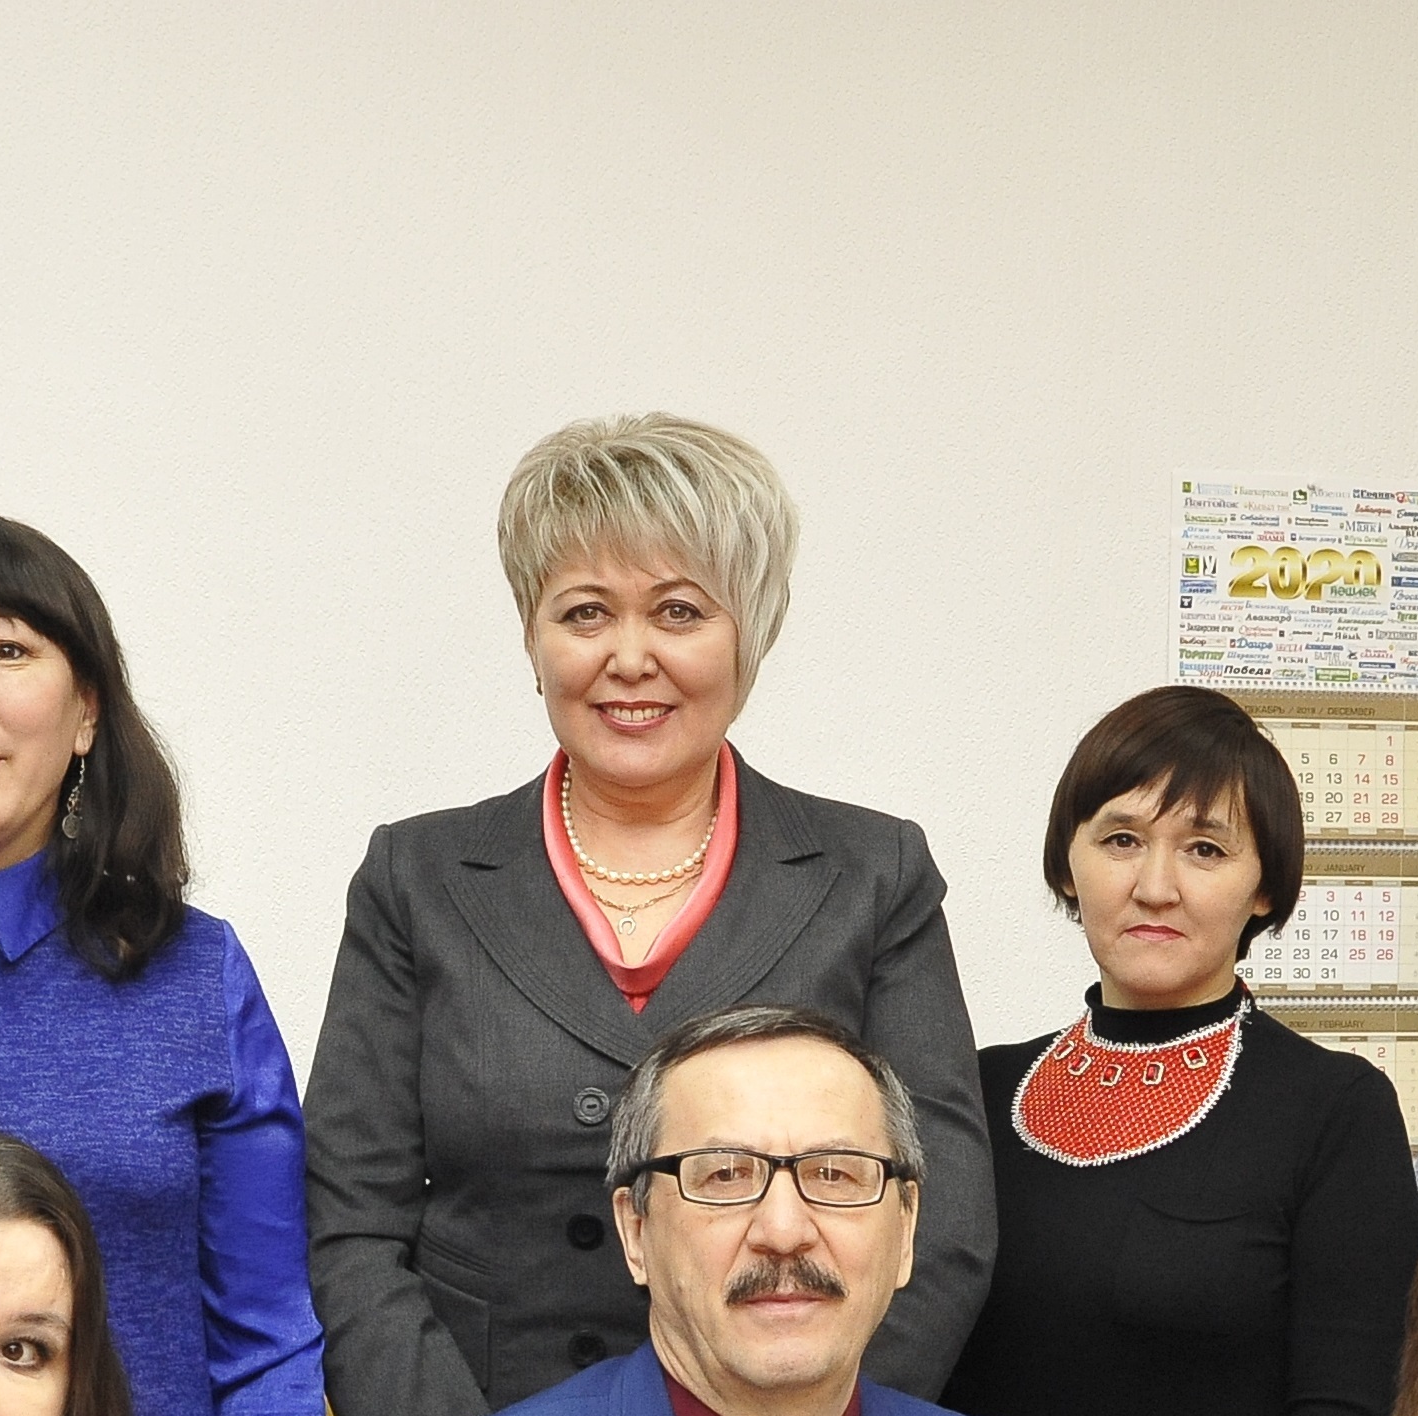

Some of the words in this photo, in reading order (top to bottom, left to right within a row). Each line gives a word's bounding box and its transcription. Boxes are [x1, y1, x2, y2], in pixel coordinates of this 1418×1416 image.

[1229, 545, 1382, 600] 2020
[1224, 665, 1272, 675] Победа
[1327, 707, 1376, 716] DECEMBER
[1387, 735, 1394, 747] 1
[1300, 753, 1311, 766] 5
[1329, 753, 1338, 766] 6
[1357, 754, 1366, 766] 7
[1385, 754, 1394, 766] 8
[1298, 772, 1314, 785] 12
[1326, 773, 1343, 785] 13
[1354, 773, 1371, 786] 14
[1382, 774, 1399, 786] 15
[1325, 792, 1343, 805] 20
[1353, 792, 1370, 805] 21
[1381, 793, 1399, 805] 22
[1325, 811, 1343, 823] 27
[1353, 812, 1371, 824] 28
[1381, 812, 1399, 824] 29
[1324, 863, 1366, 873] JANUARY
[1326, 891, 1335, 902] 3
[1354, 891, 1363, 903] 4
[1382, 891, 1391, 903] 5
[1297, 910, 1307, 921] 9
[1323, 910, 1340, 922] 10
[1351, 910, 1366, 922] 11
[1378, 911, 1395, 923] 12
[1294, 929, 1311, 940] 16
[1323, 929, 1339, 941] 17
[1350, 930, 1367, 941] 18
[1378, 930, 1395, 941] 19
[1264, 948, 1282, 960] 22
[1292, 948, 1310, 960] 23
[1321, 949, 1338, 960] 24
[1349, 949, 1366, 960] 25
[1376, 949, 1394, 960] 26
[1264, 967, 1282, 979] 29
[1292, 967, 1311, 979] 30
[1321, 967, 1337, 979] 31
[1378, 1047, 1387, 1058] 2
